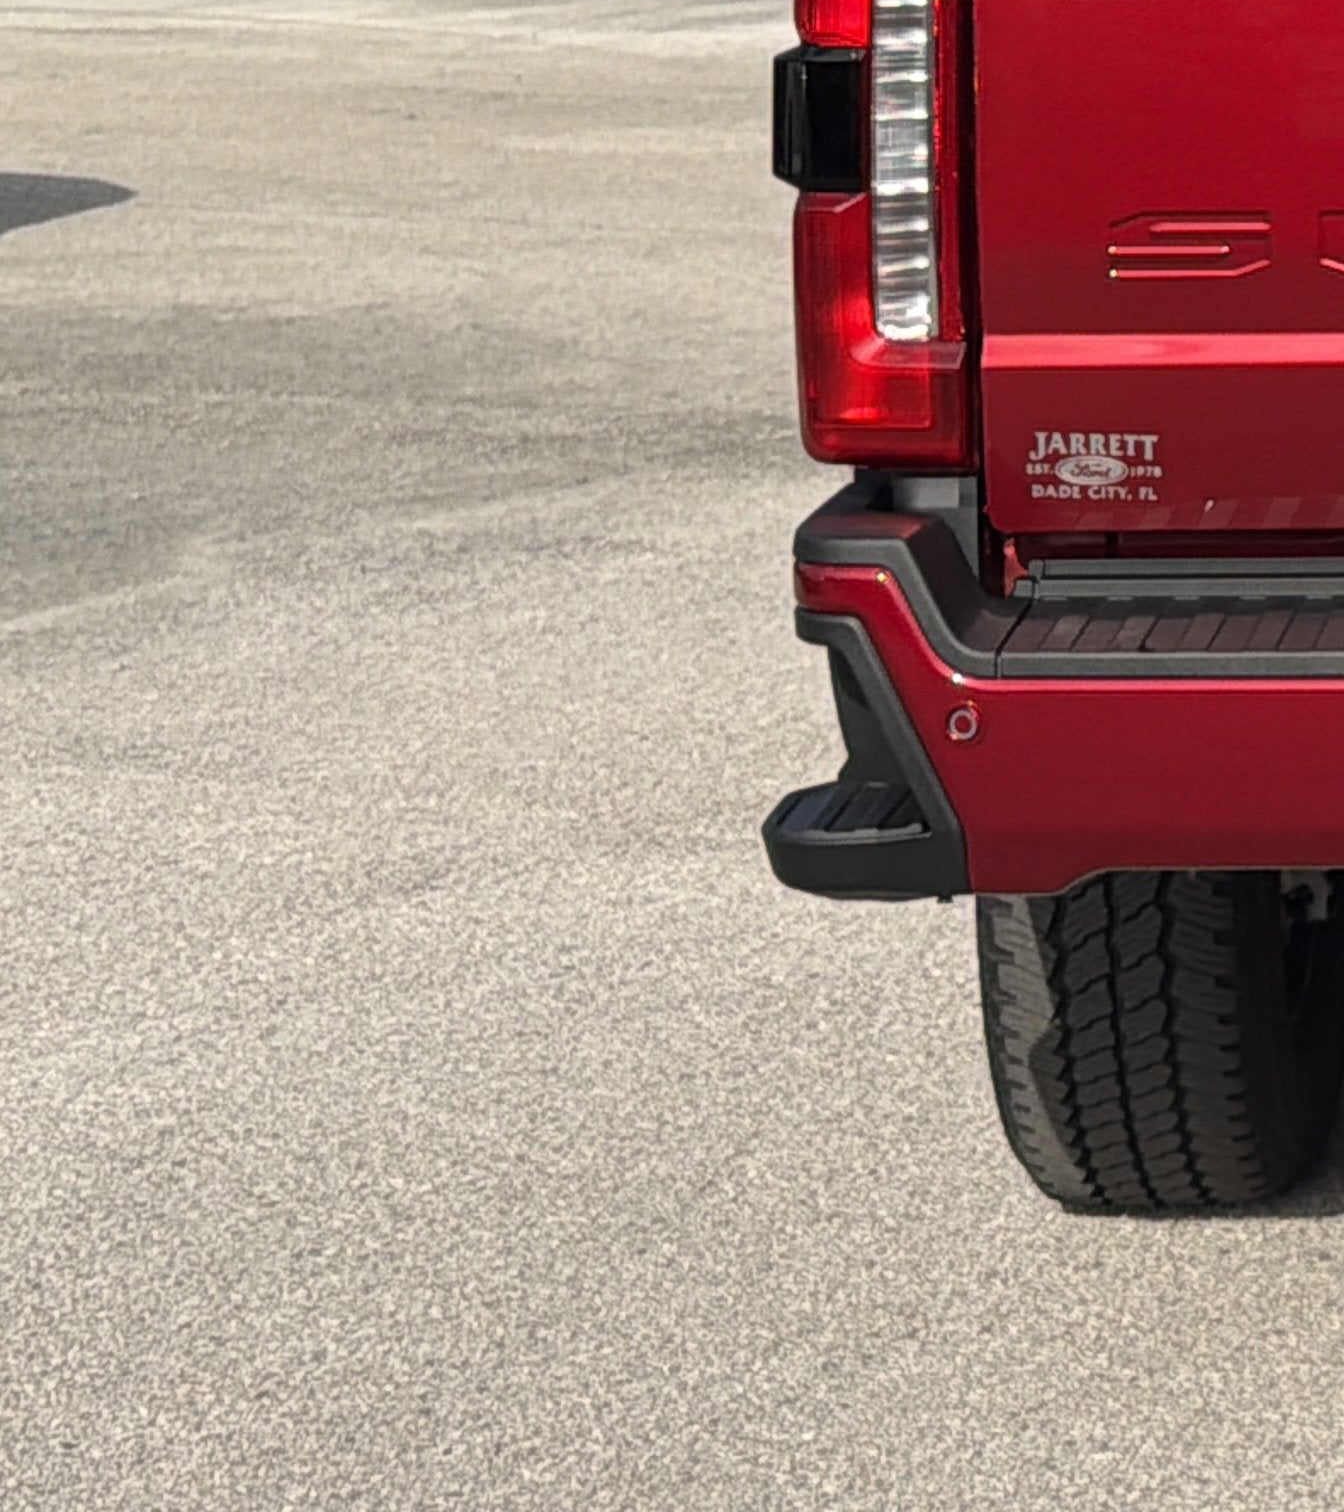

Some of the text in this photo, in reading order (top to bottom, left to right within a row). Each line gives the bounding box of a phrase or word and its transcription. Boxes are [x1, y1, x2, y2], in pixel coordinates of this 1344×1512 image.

[1028, 431, 1160, 461] JARRETT
[1071, 462, 1113, 478] Ford
[1031, 484, 1082, 499] DADE
[1138, 486, 1159, 501] FL
